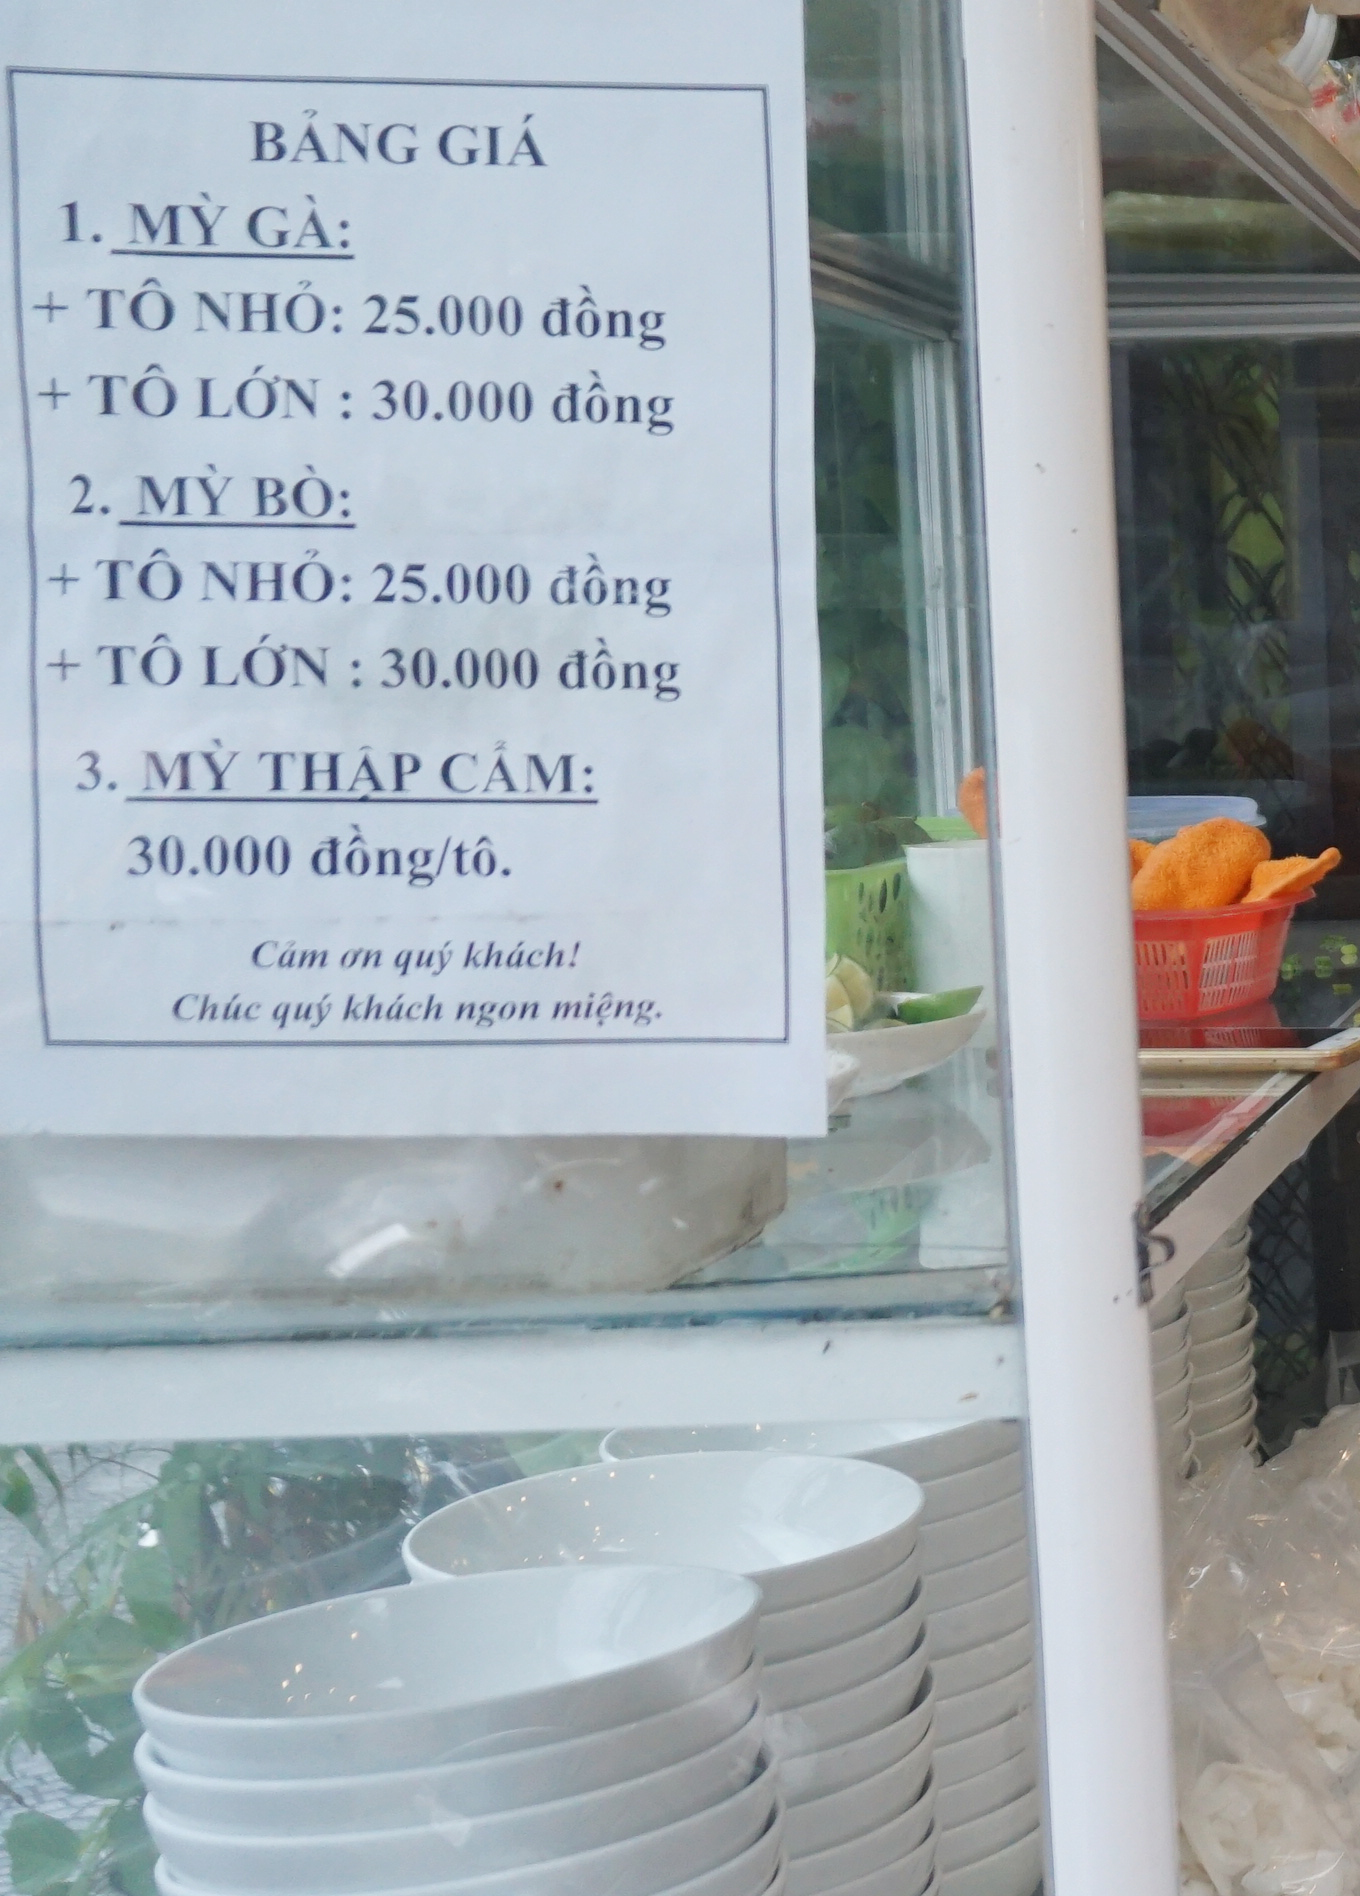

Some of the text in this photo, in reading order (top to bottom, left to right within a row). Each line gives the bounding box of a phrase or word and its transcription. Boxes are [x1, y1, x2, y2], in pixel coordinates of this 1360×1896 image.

[250, 108, 549, 168] BẢNG GIÁ
[60, 190, 351, 250] 1. MỲ GÀ:
[32, 276, 668, 352] + TÔ NHỎ: 25.000 đồng
[37, 363, 676, 438] + TÔ LỚN : 30.000 đồng
[70, 463, 352, 520] 2. MỲ BÒ:
[47, 547, 673, 619] + TÔ NHỎ: 25.000 đồng
[46, 632, 683, 704] + TÔ LỚN : 30.000 đồng
[75, 738, 595, 800] 3. MỲ THẬP CẨM:
[125, 823, 513, 888] 30.000 đồng/tô.
[250, 939, 582, 978] Cảm ơn quý khách!
[170, 990, 663, 1030] Chúc quý khách ngon miệng.
